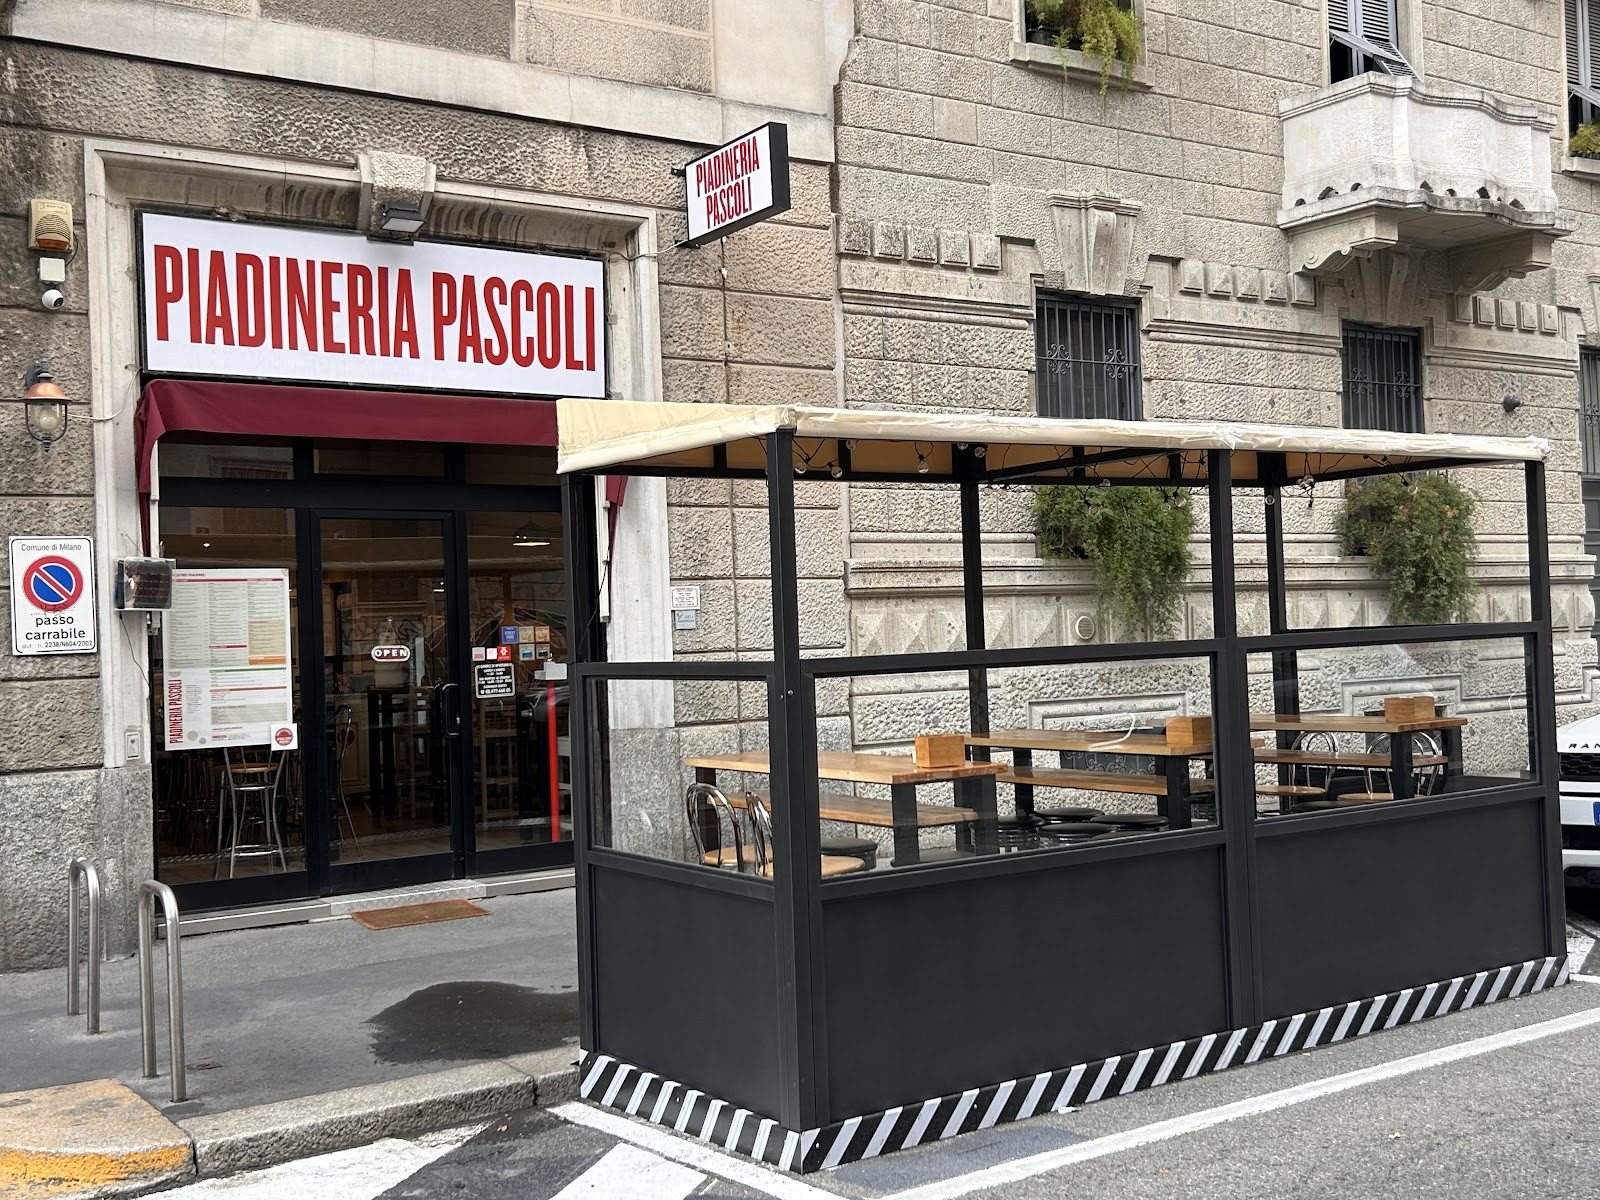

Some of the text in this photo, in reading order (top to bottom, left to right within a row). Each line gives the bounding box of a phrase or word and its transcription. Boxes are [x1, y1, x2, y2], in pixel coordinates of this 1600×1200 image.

[695, 135, 760, 198] PIADINERIA
[706, 176, 752, 229] PASCOLI
[154, 244, 596, 373] PIADINERIA PASCOLI
[21, 543, 49, 551] Comune
[59, 543, 82, 551] Milano
[35, 615, 74, 628] passo
[25, 628, 86, 640] carrabile
[44, 640, 93, 648] 2238/N604/2002
[374, 649, 407, 657] OPEN
[168, 679, 184, 744] PIADINERIA PASCOLI
